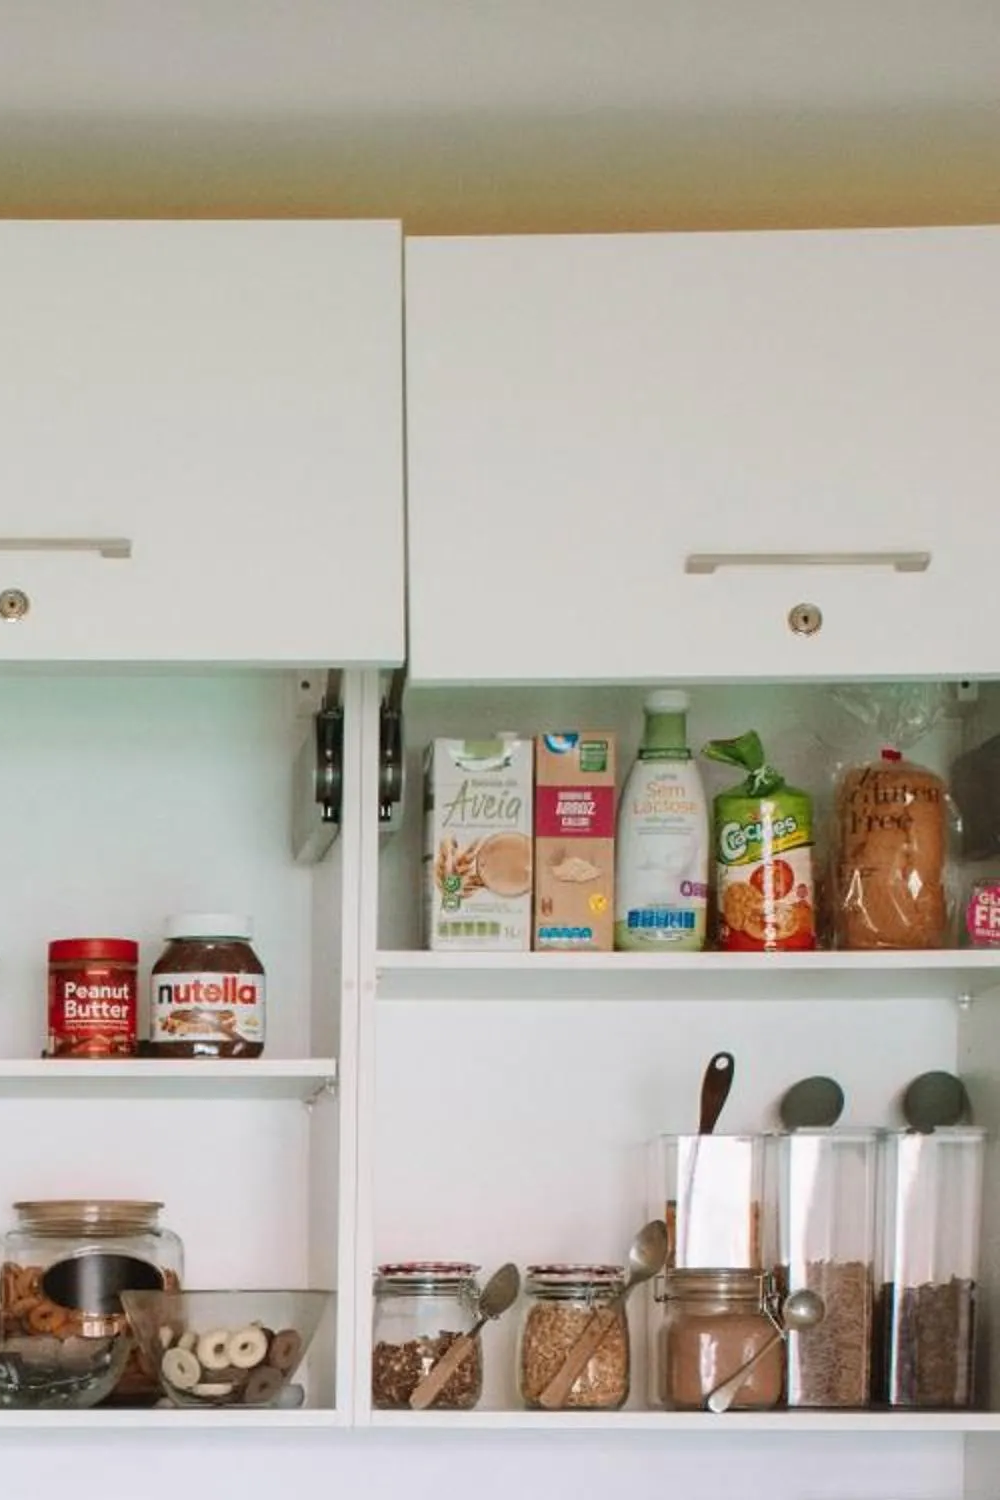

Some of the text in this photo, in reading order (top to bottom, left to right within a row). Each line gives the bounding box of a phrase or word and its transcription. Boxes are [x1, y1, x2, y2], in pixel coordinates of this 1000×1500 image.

[442, 779, 521, 827] Aveia
[64, 981, 129, 1000] Peanut
[158, 976, 257, 1005] nutella
[64, 1001, 129, 1019] Butter
